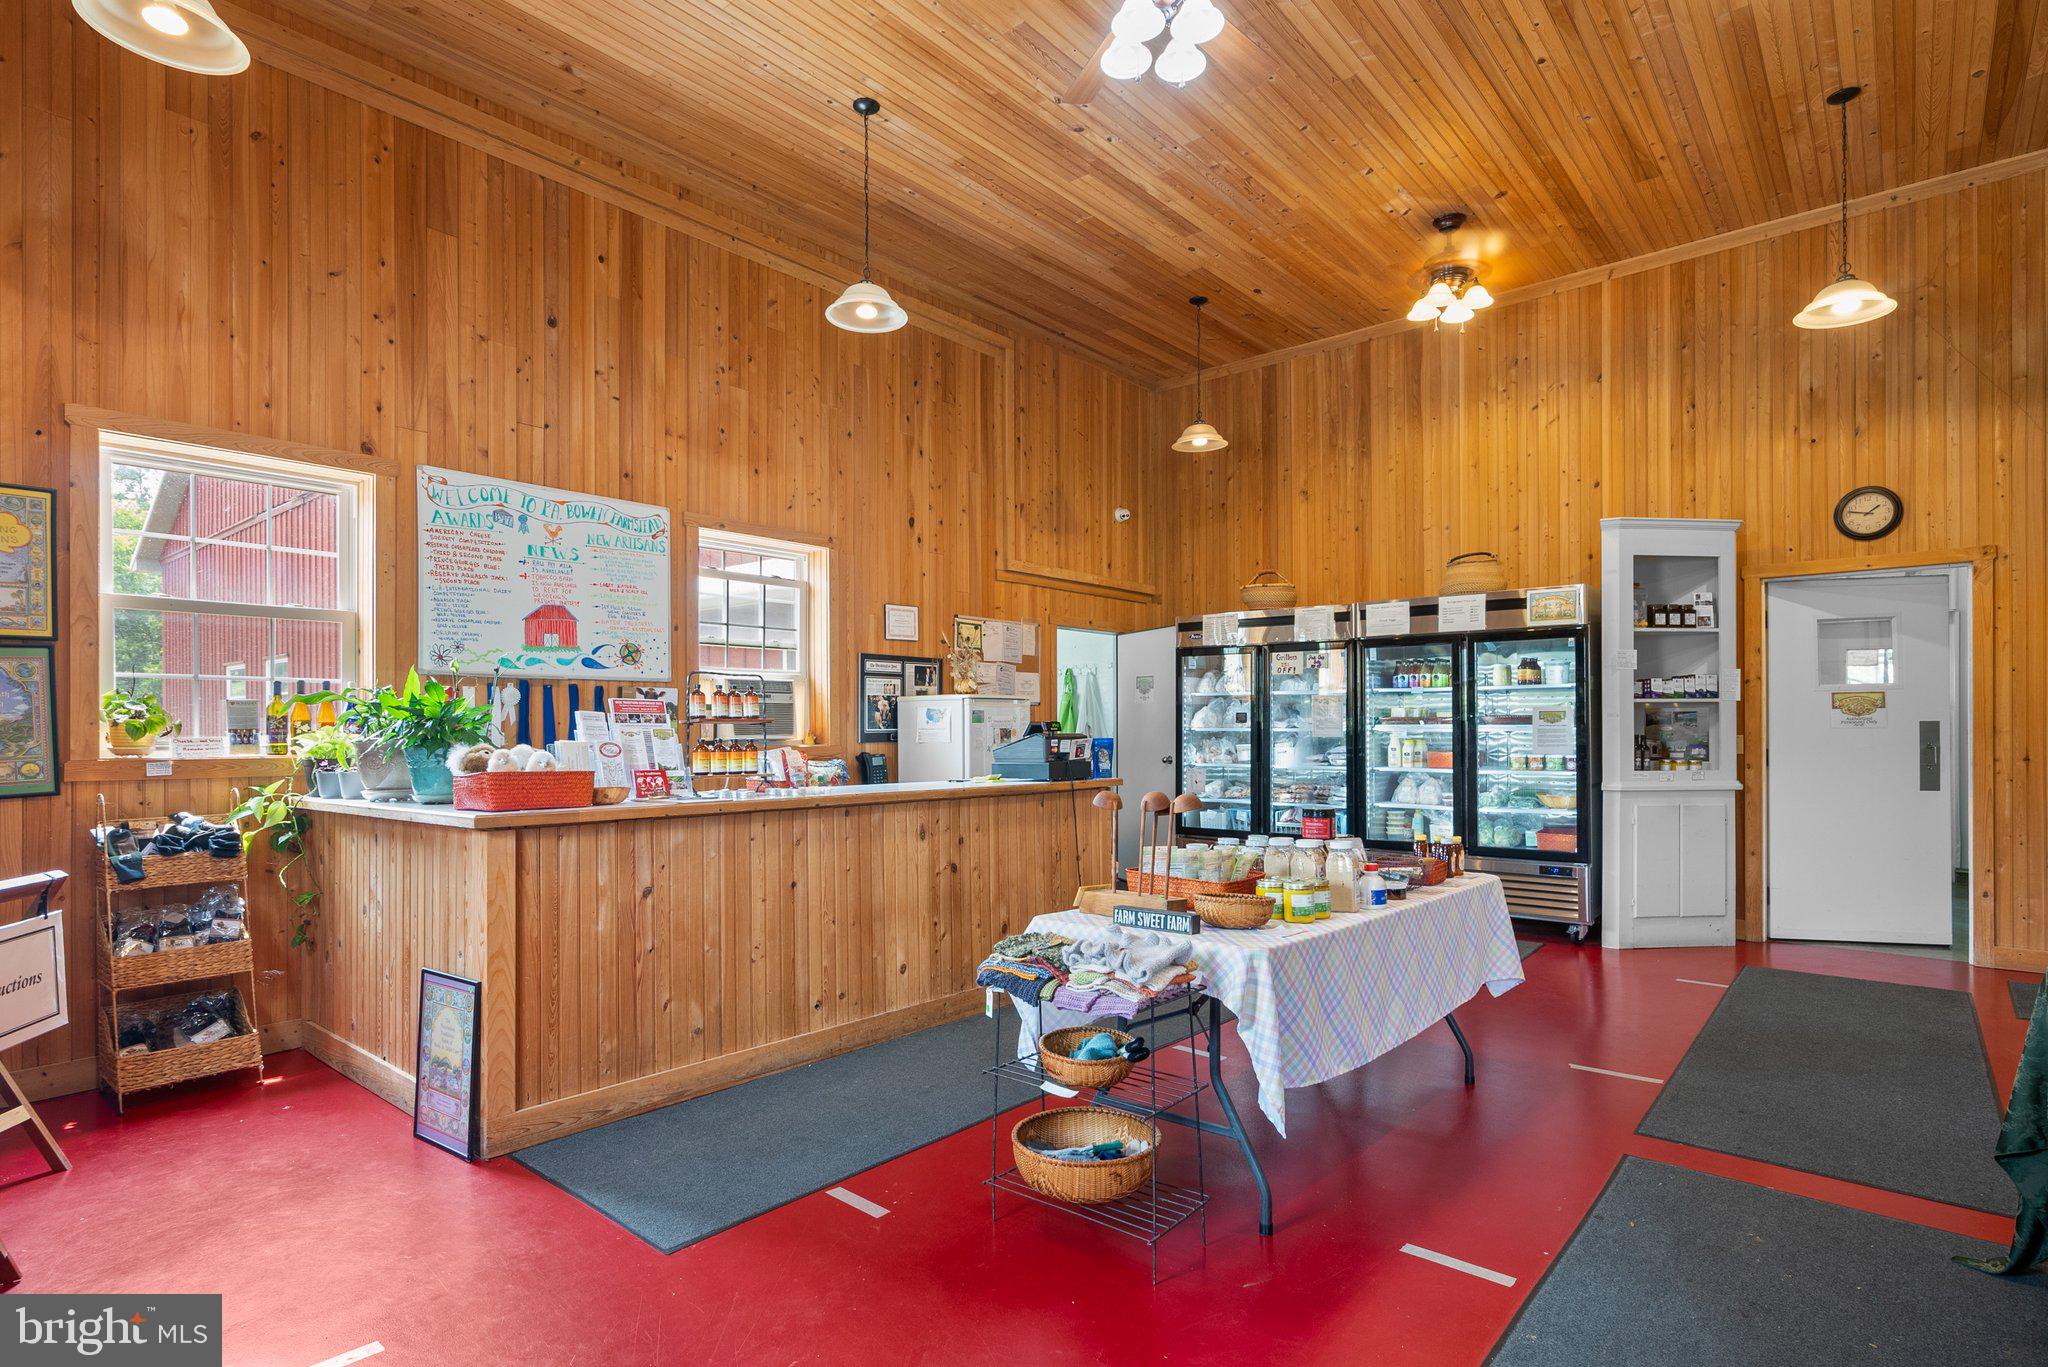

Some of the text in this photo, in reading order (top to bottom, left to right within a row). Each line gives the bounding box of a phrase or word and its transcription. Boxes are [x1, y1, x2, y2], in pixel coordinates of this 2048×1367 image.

[431, 485, 510, 506] WELCOME
[521, 495, 537, 513] TO
[611, 513, 664, 533] FARMSTEAD
[431, 509, 494, 530] AWARDS
[428, 528, 464, 536] AMERICAN
[527, 544, 579, 561] NEWS
[587, 533, 611, 547] NEW
[614, 535, 666, 553] ARTISANS
[459, 552, 483, 560] SECOND
[1114, 909, 1190, 933] FARM SWEET FARM
